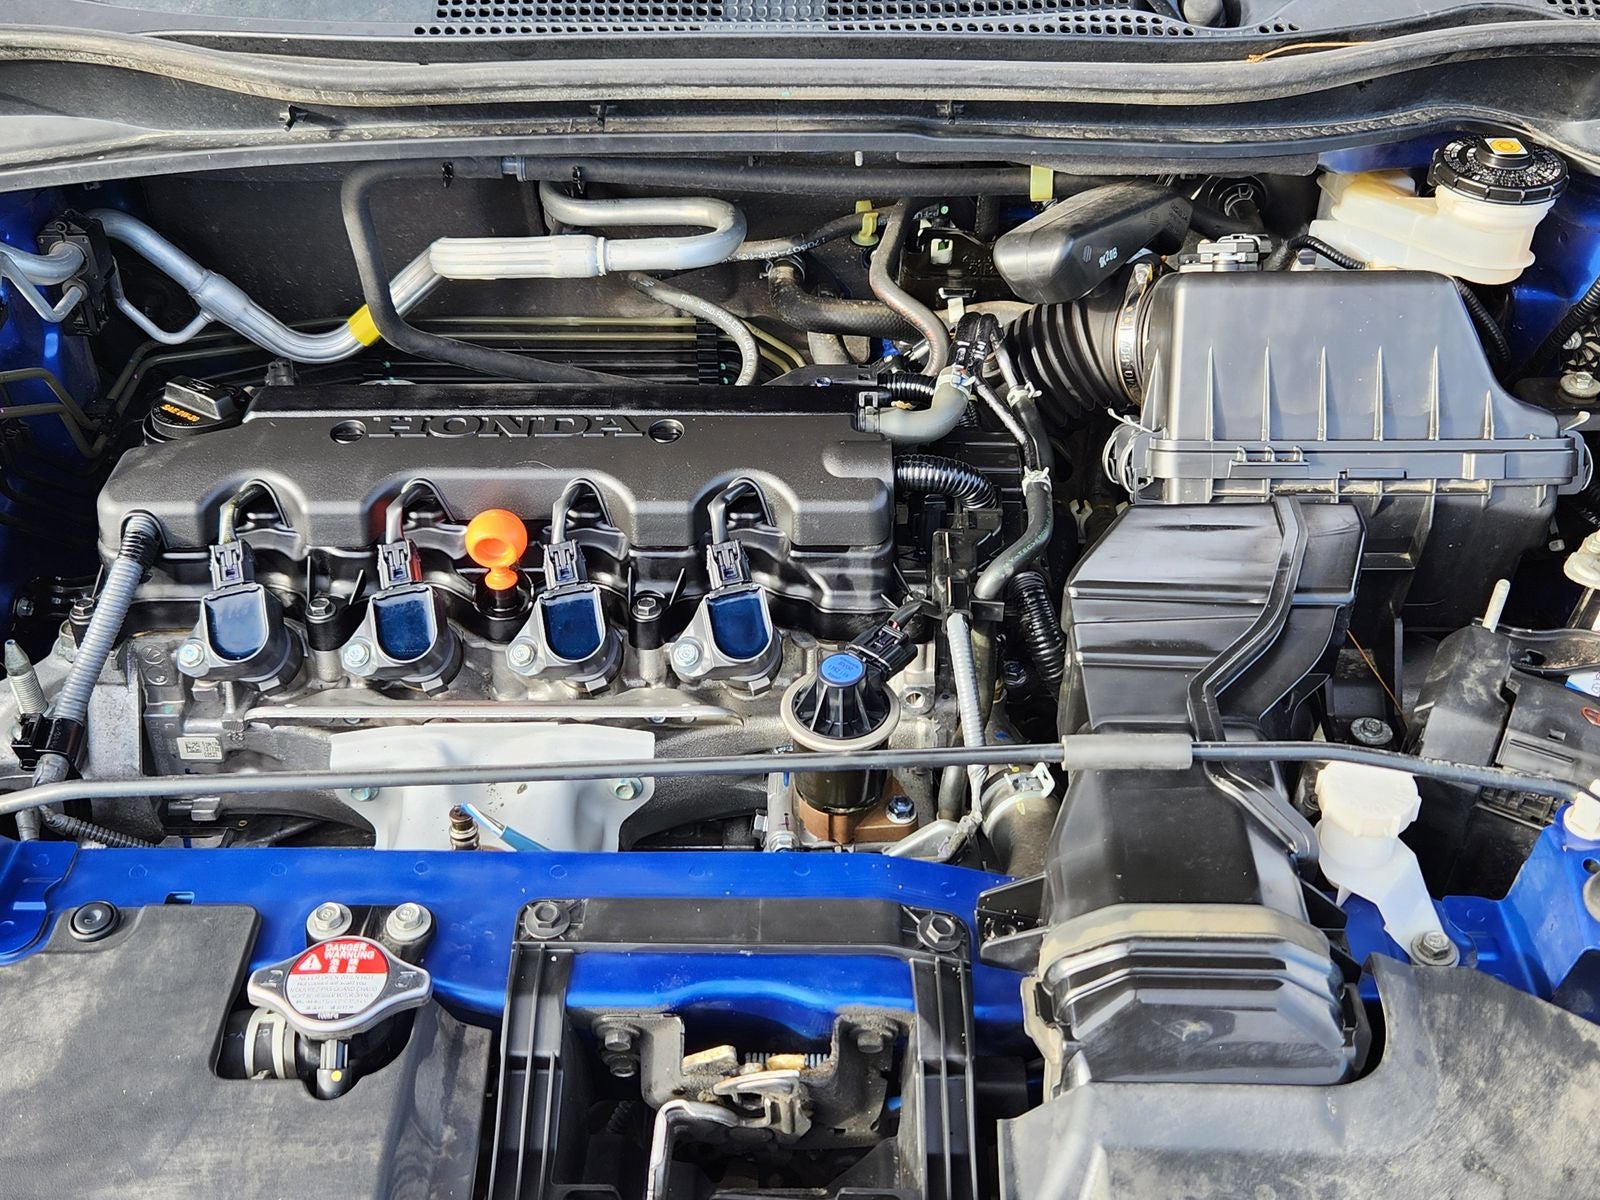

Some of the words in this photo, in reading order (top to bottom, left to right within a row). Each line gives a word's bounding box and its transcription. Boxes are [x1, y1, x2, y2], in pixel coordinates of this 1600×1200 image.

[368, 415, 645, 438] HONDA
[325, 943, 368, 951] DANGER
[324, 950, 375, 960] WARNUNG
